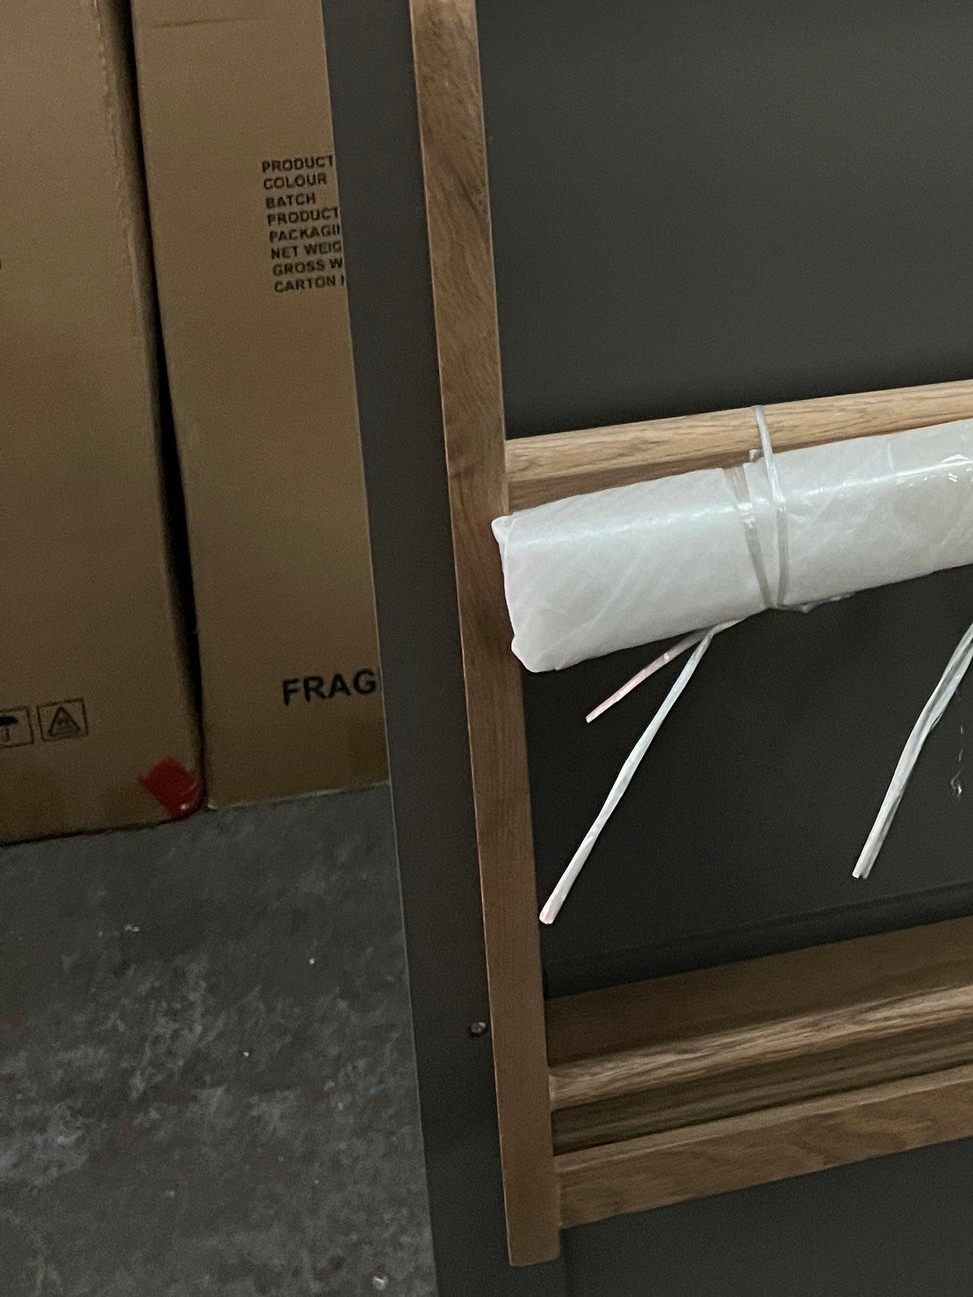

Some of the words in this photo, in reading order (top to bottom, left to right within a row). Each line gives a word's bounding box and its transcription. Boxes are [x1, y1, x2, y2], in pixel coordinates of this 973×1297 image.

[262, 155, 333, 173] PRODUCT
[263, 172, 327, 190] COLOUR
[265, 192, 316, 209] BATCH
[267, 207, 339, 226] PRODUCT
[271, 246, 299, 259] NET
[272, 259, 326, 276] GROSS
[274, 275, 336, 293] CARTON
[283, 668, 377, 706] FRAG
